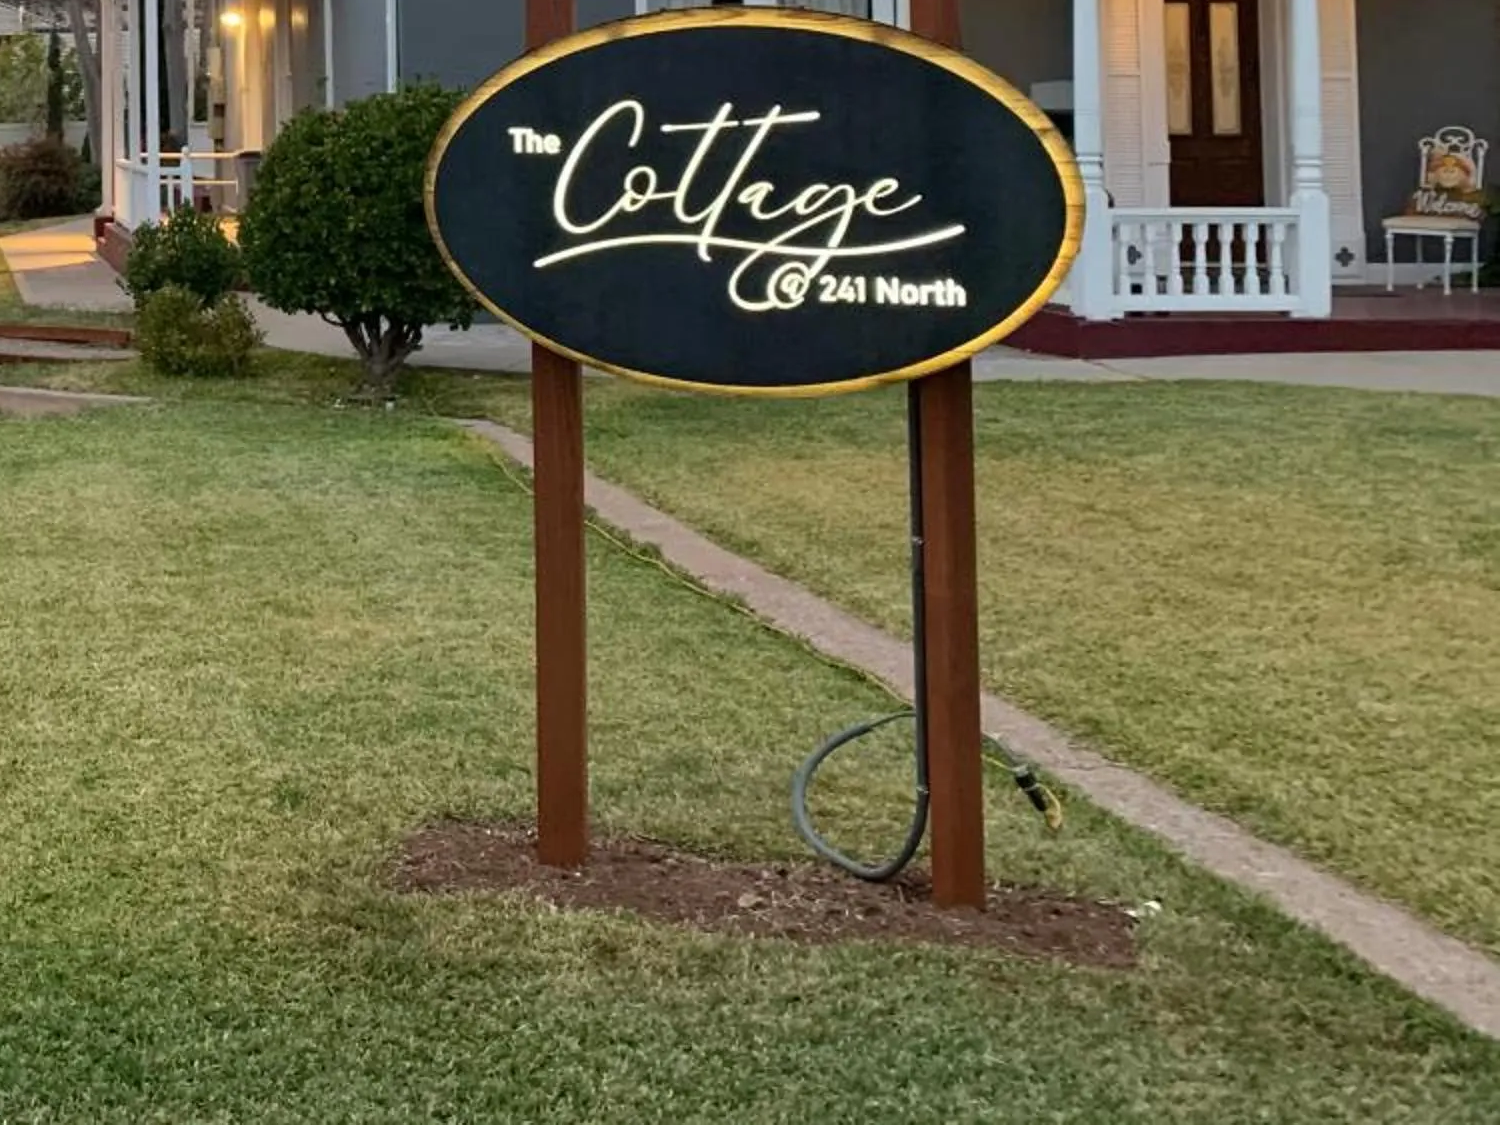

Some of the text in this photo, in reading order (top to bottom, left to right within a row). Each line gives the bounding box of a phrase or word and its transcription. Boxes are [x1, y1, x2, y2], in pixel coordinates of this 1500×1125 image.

[508, 99, 923, 310] The Cottage
[767, 262, 967, 309] @ 241 North
